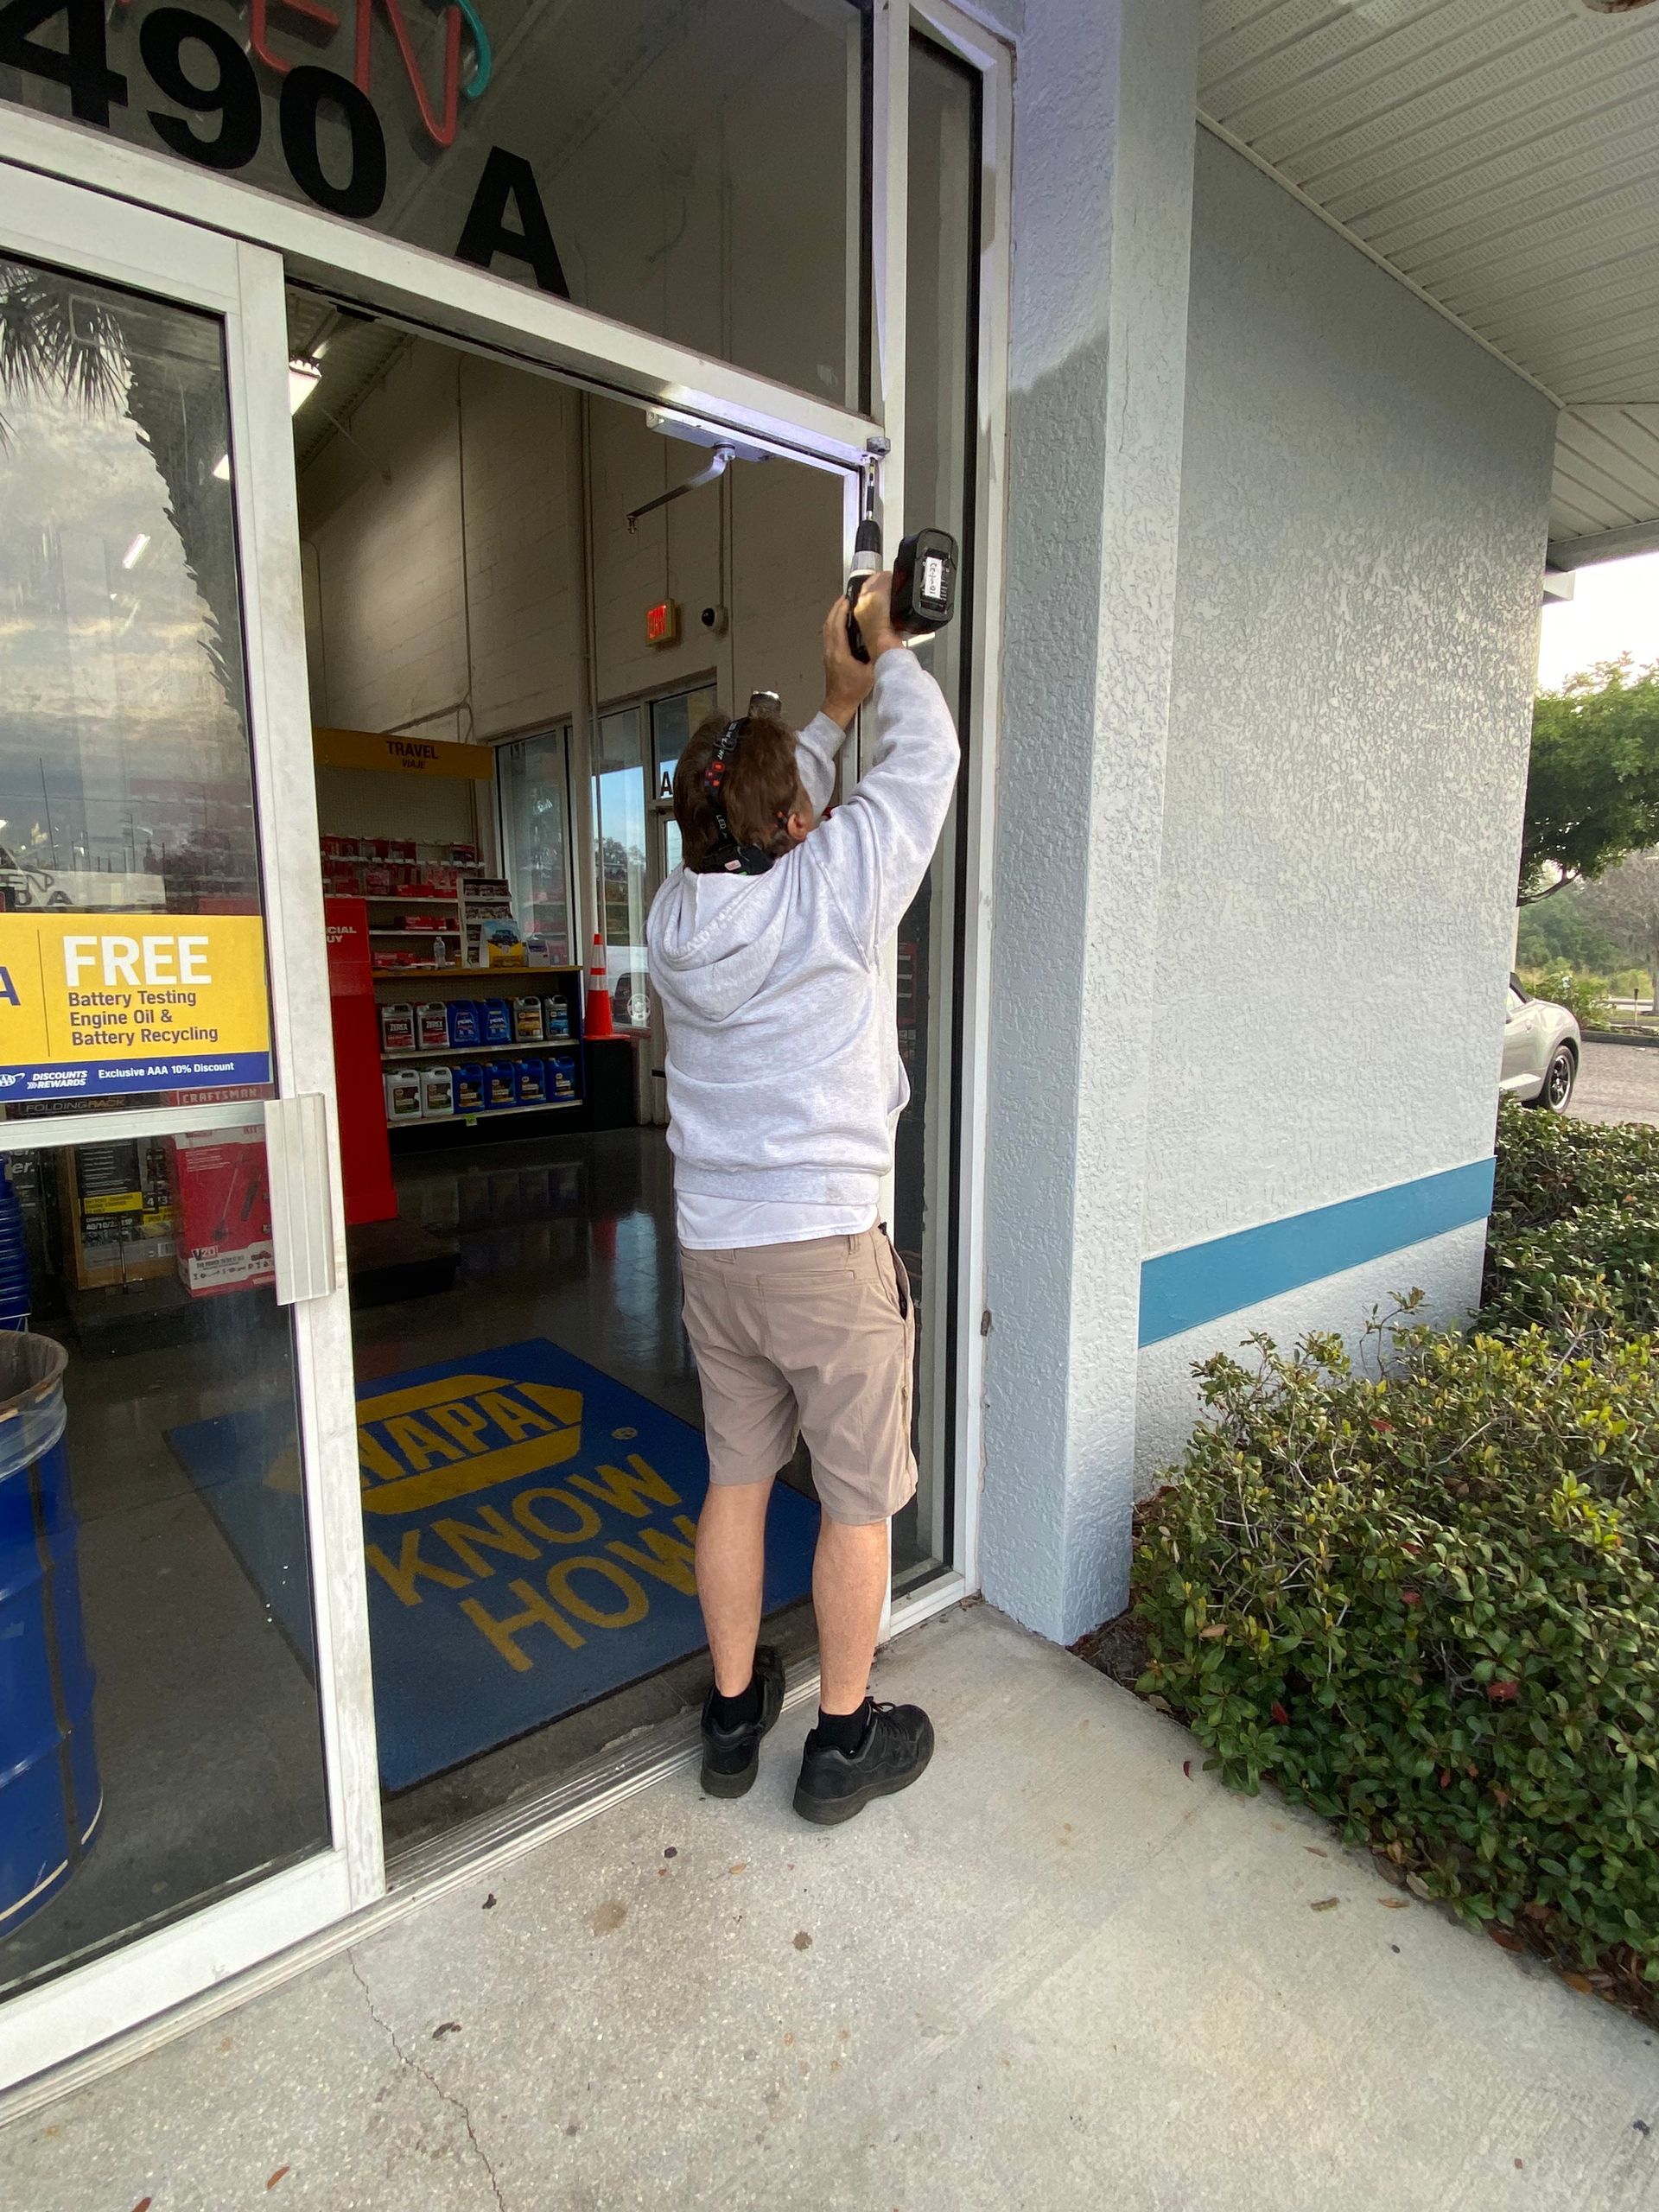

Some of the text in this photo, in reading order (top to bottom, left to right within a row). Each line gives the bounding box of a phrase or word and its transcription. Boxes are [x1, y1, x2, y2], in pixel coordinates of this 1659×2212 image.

[454, 145, 570, 300] A
[386, 741, 438, 759] TRAVEL
[402, 758, 426, 769] VIAJE
[327, 925, 358, 934] CIAL
[63, 935, 212, 987] FREE
[68, 990, 197, 1007] Battery Testing
[70, 1009, 173, 1028] Engine Oil &
[72, 1027, 219, 1046] Battery Recycling
[33, 1071, 88, 1081] DISCOUNTS
[98, 1062, 235, 1079] Exclusive AAA 10% Discount
[37, 1078, 86, 1089] REWARDS
[182, 1088, 257, 1104] CRAFTSMAN
[359, 1391, 556, 1485] NAPA
[366, 1454, 682, 1607] KNOW
[459, 1515, 697, 1672] HOW
